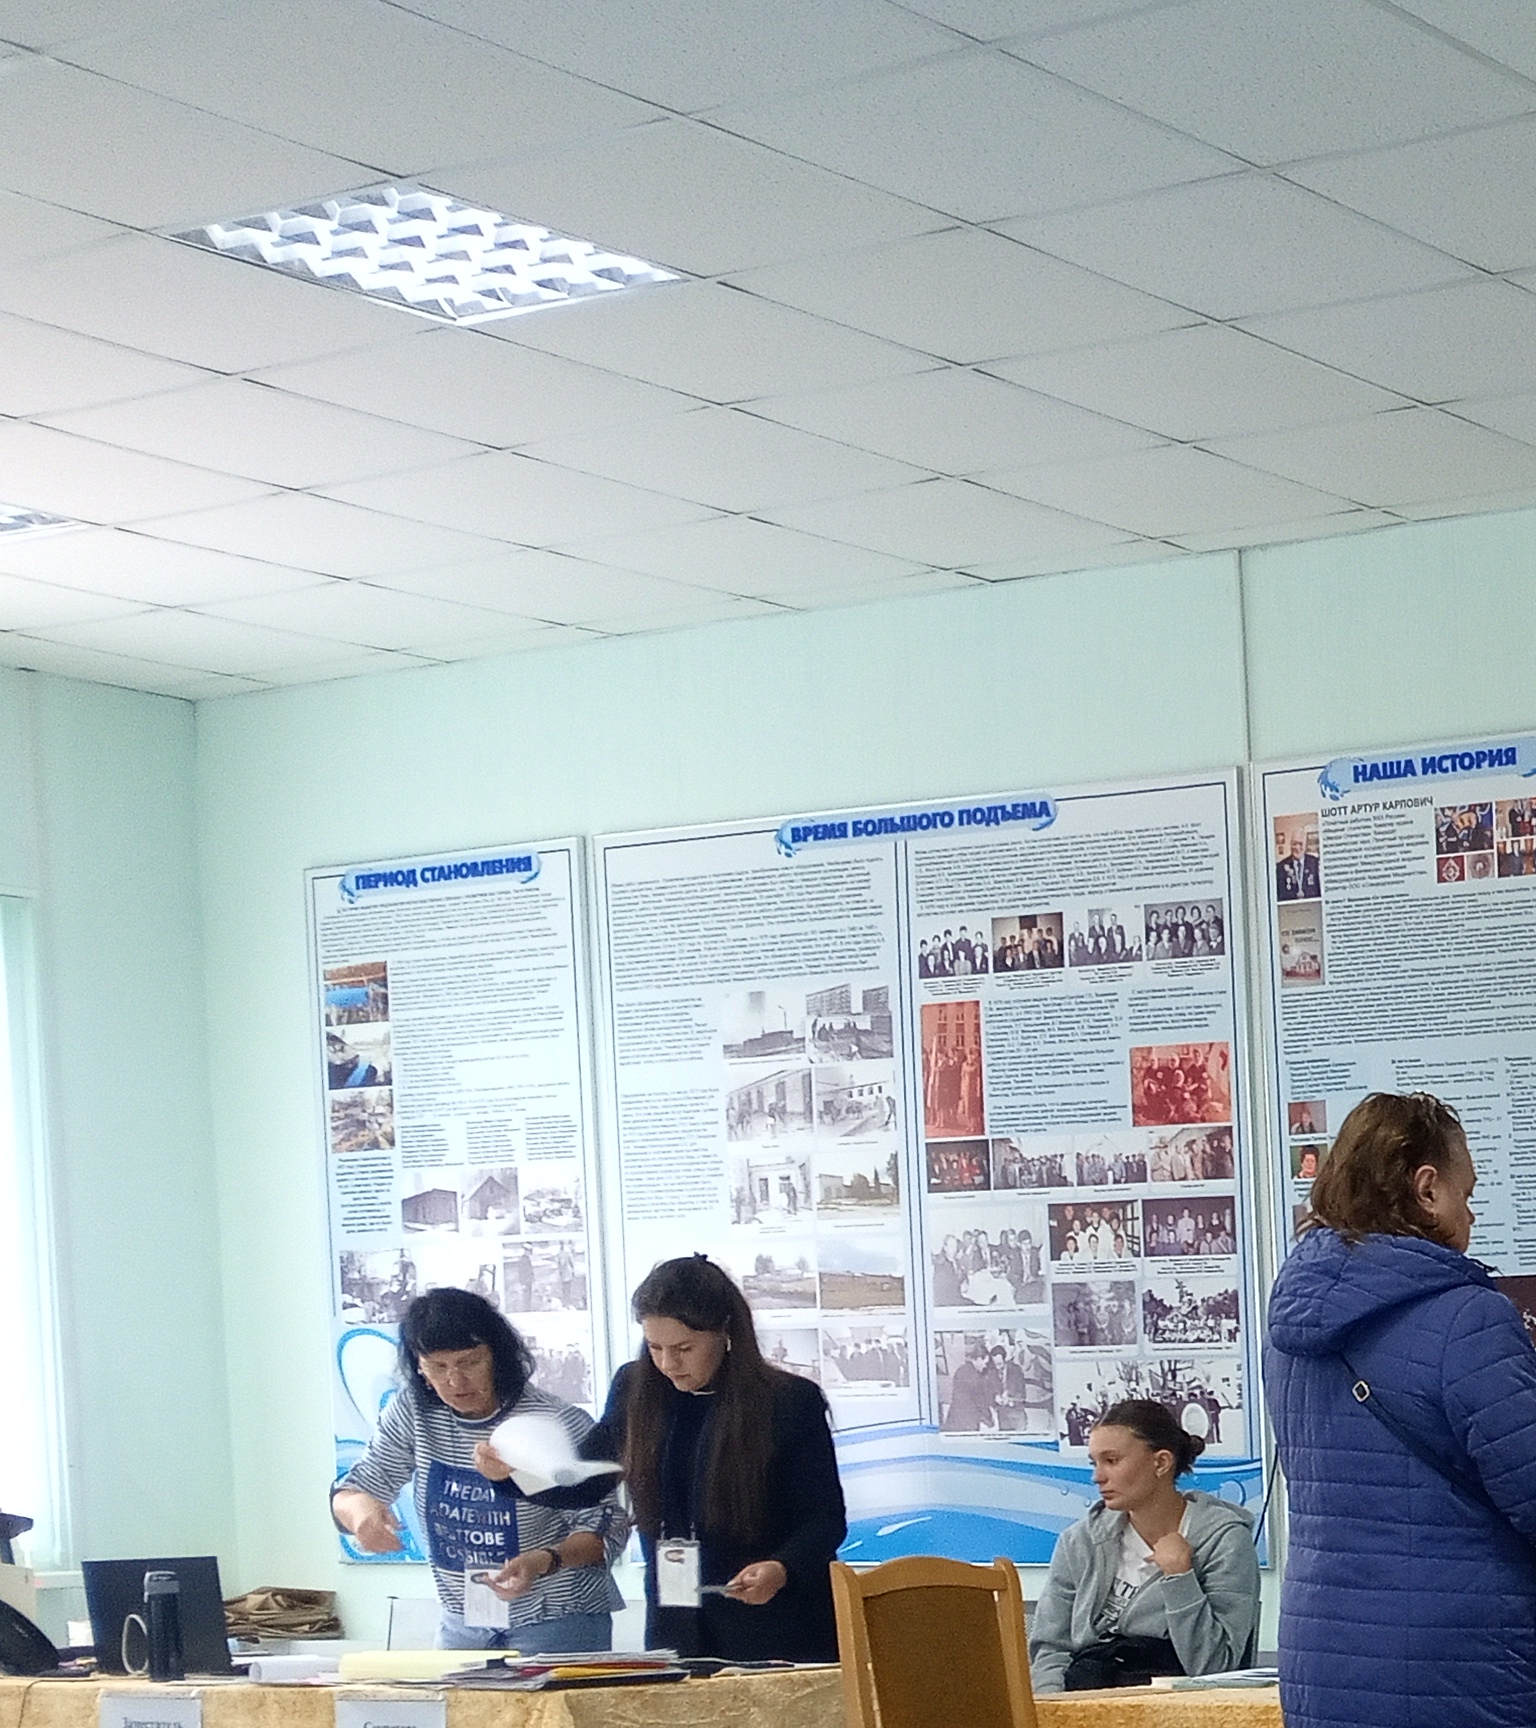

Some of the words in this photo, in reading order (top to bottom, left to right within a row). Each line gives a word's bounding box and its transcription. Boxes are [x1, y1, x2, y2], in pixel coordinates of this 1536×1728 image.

[1353, 758, 1417, 783] НАША
[1422, 746, 1517, 774] ИСТОРИЯ
[791, 821, 848, 844] ВРЕМЯ
[852, 810, 955, 838] БОЛЬШОГО
[958, 801, 1050, 827] ПОДЪЕМА
[1321, 805, 1348, 817] ШОТТ
[1350, 802, 1380, 814] АРТУР
[1382, 796, 1434, 810] КАРПОВИЧ
[355, 868, 418, 890] ПЕРИОД
[420, 855, 533, 883] СТАНОВЛЕНИЯ
